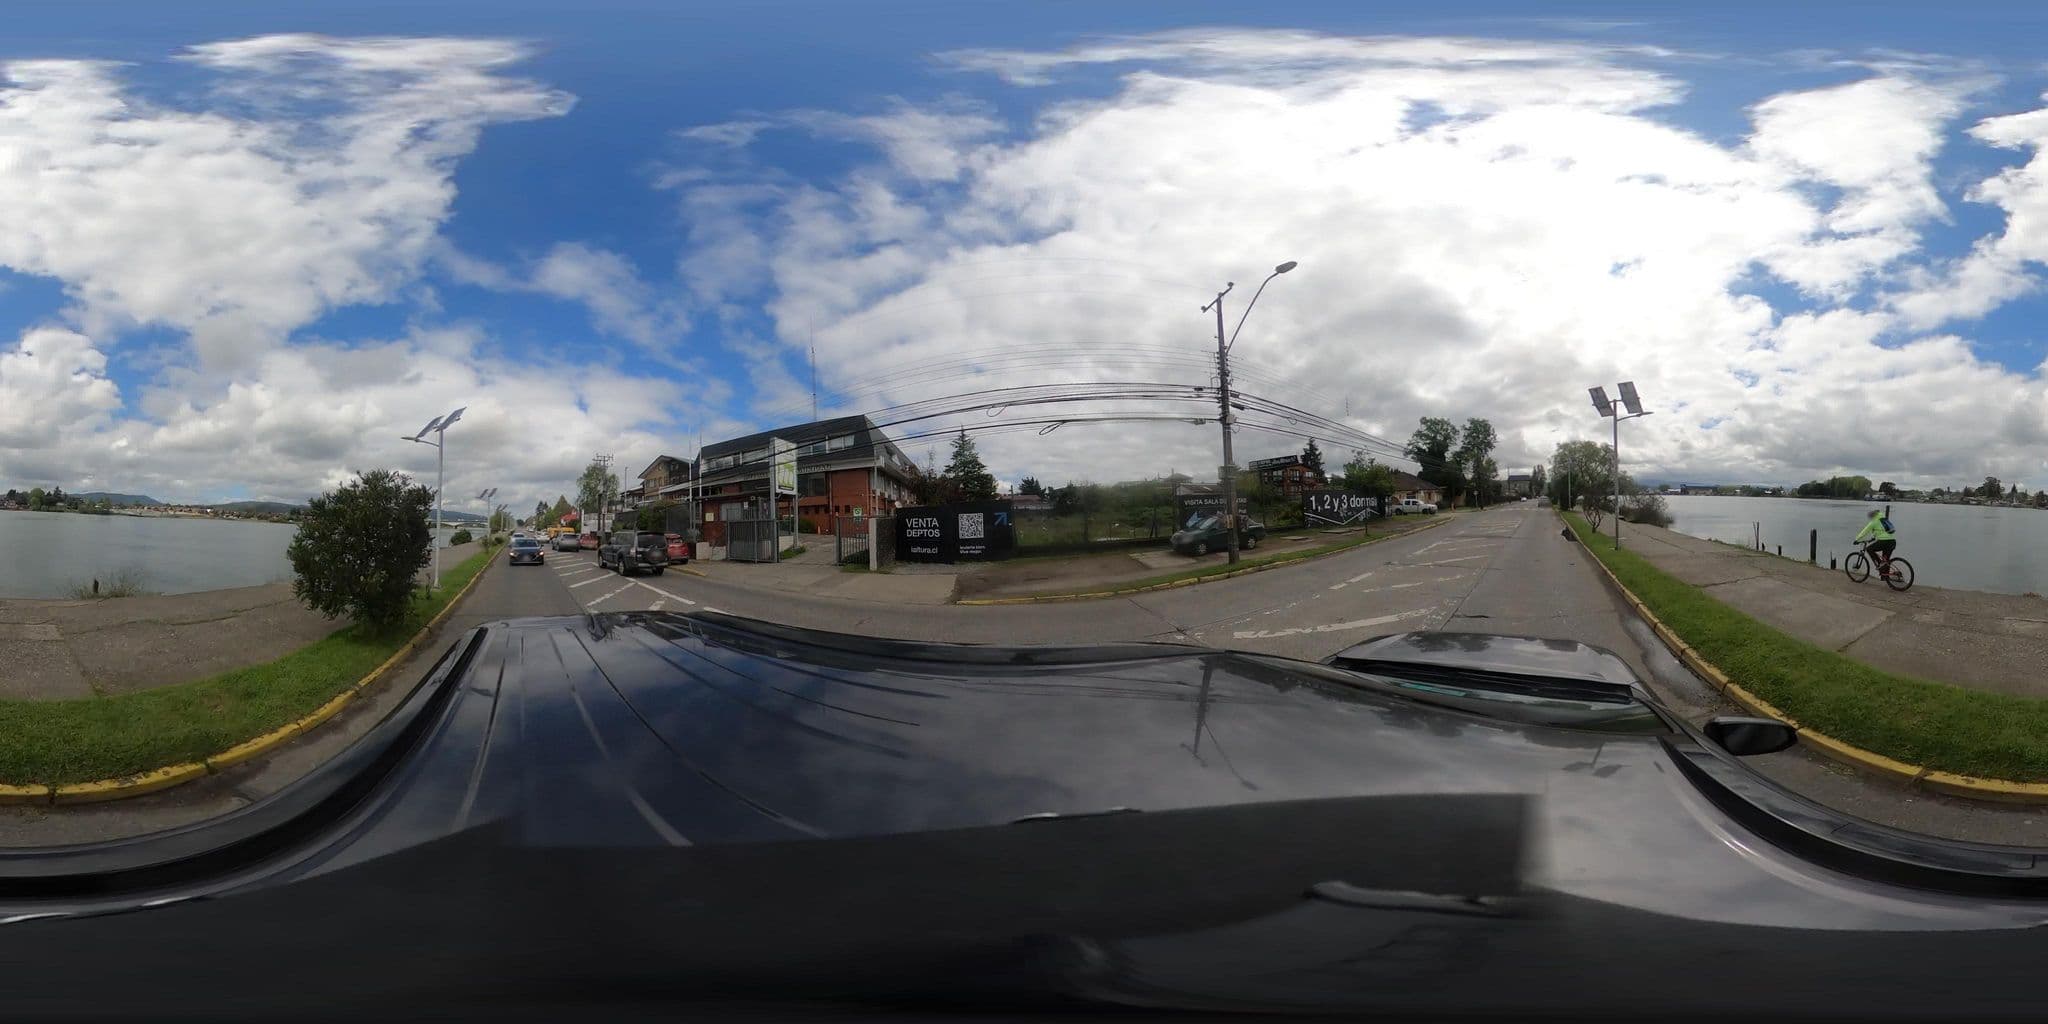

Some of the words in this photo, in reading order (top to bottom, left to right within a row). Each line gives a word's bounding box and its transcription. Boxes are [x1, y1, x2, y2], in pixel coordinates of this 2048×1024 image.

[1324, 494, 1332, 509] 2
[1333, 497, 1340, 512] y
[1341, 494, 1348, 508] 3
[905, 517, 939, 528] VENTA
[906, 529, 940, 537] DEPTOS
